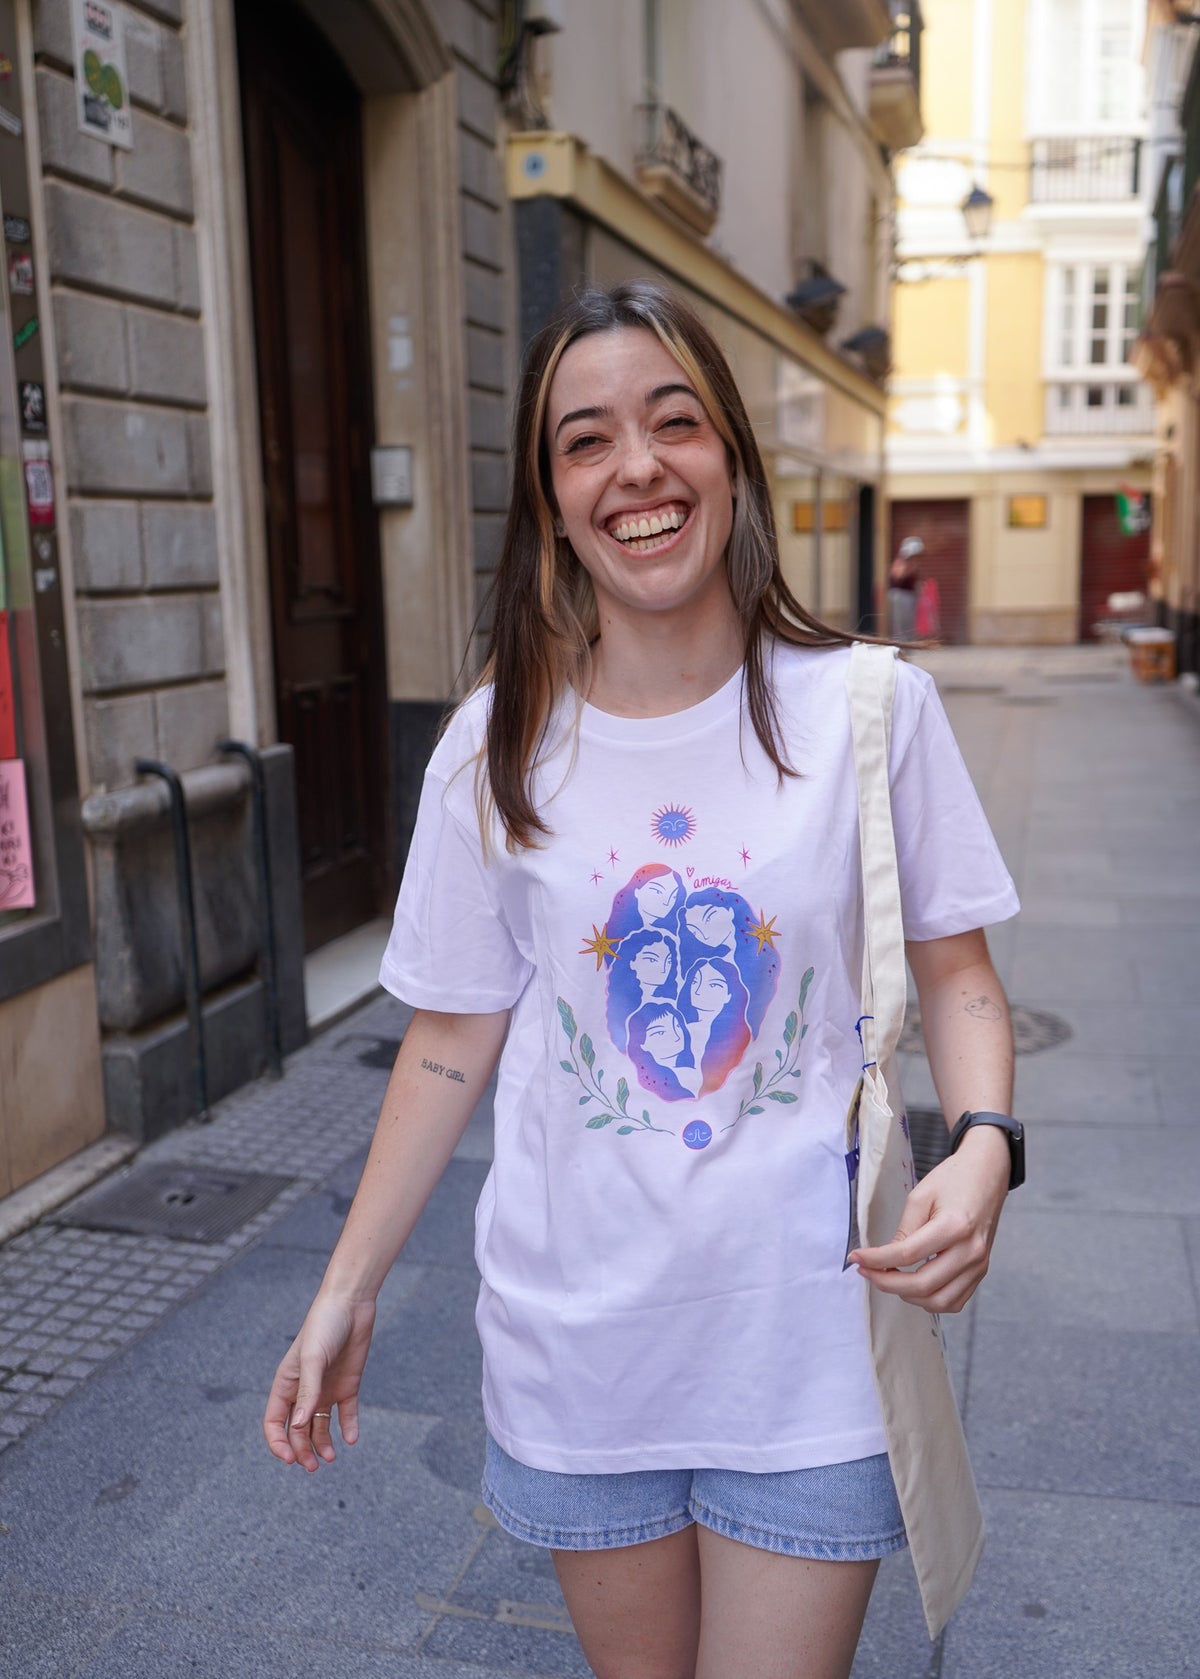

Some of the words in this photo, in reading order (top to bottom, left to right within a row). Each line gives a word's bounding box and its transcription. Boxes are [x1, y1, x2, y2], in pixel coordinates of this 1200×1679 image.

[693, 875, 739, 890] amigas
[421, 1058, 446, 1076] BABY
[445, 1068, 466, 1084] GIRL
